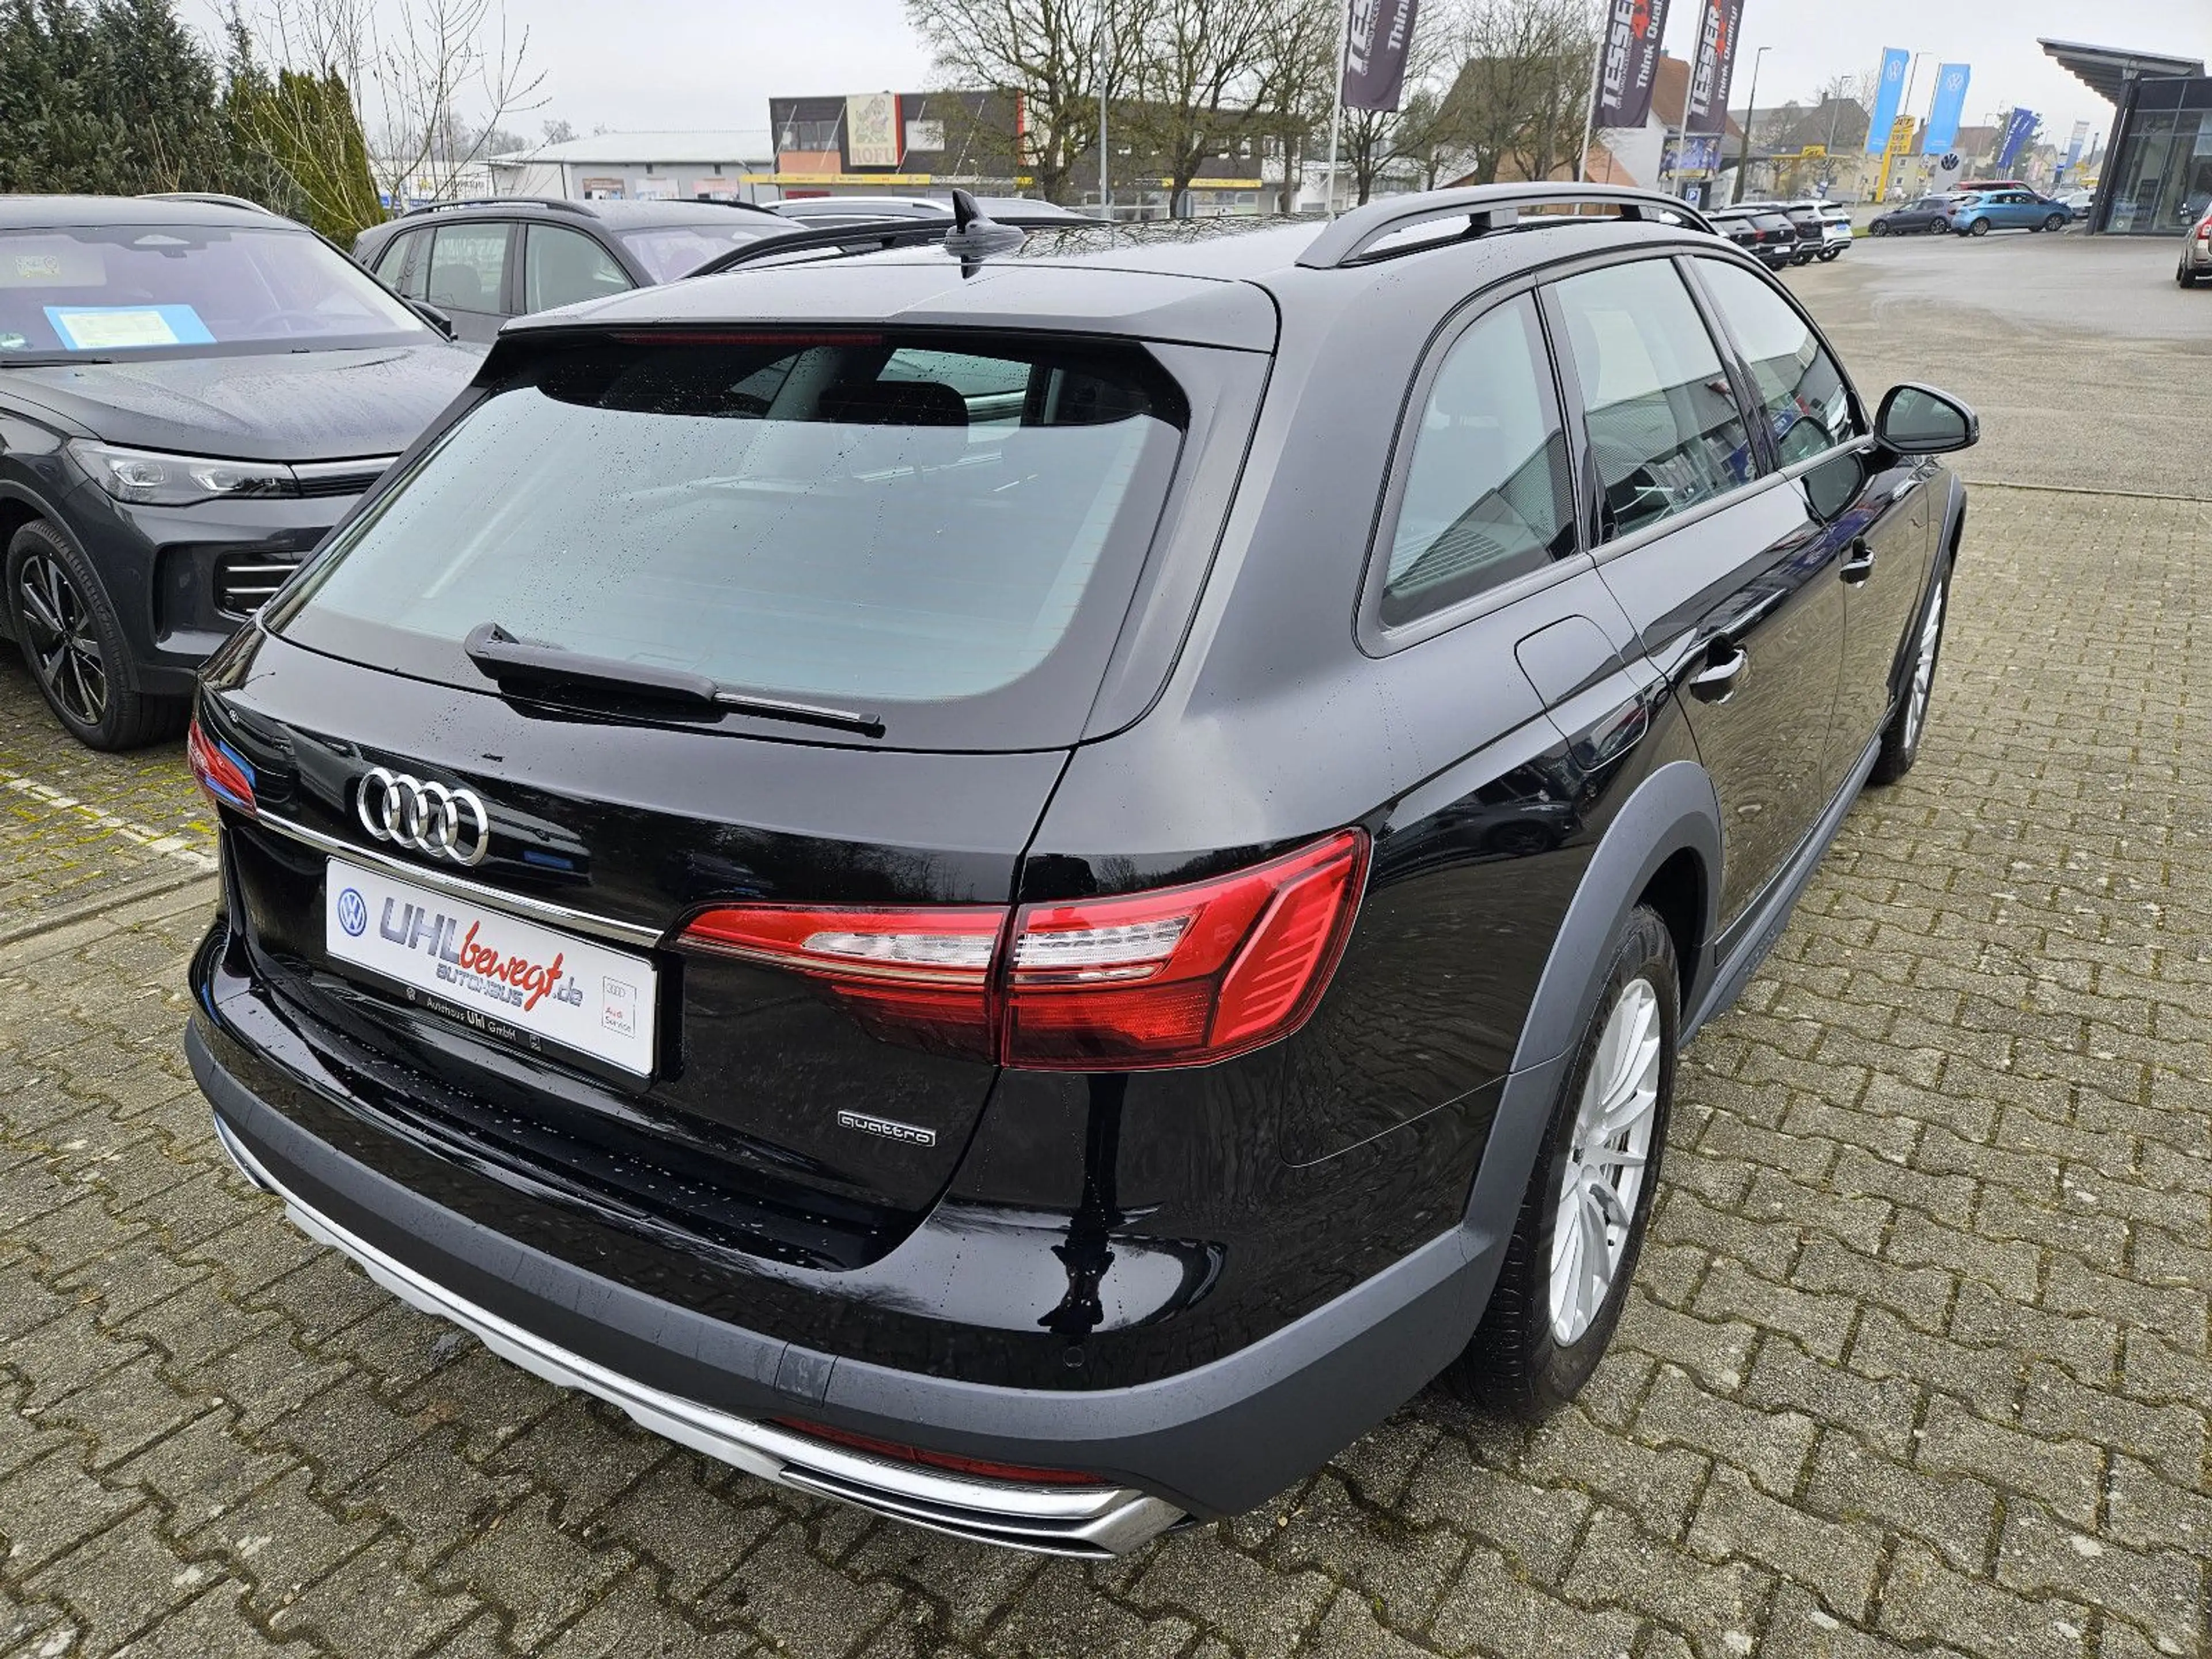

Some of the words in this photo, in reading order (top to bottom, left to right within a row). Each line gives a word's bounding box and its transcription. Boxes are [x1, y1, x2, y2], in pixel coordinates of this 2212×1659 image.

[1601, 0, 1634, 108] TESSE
[1636, 44, 1655, 88] Think
[1717, 63, 1729, 100] Think
[851, 147, 896, 163] ROFU
[467, 1010, 485, 1030] Uhl
[841, 1116, 930, 1143] quattro
